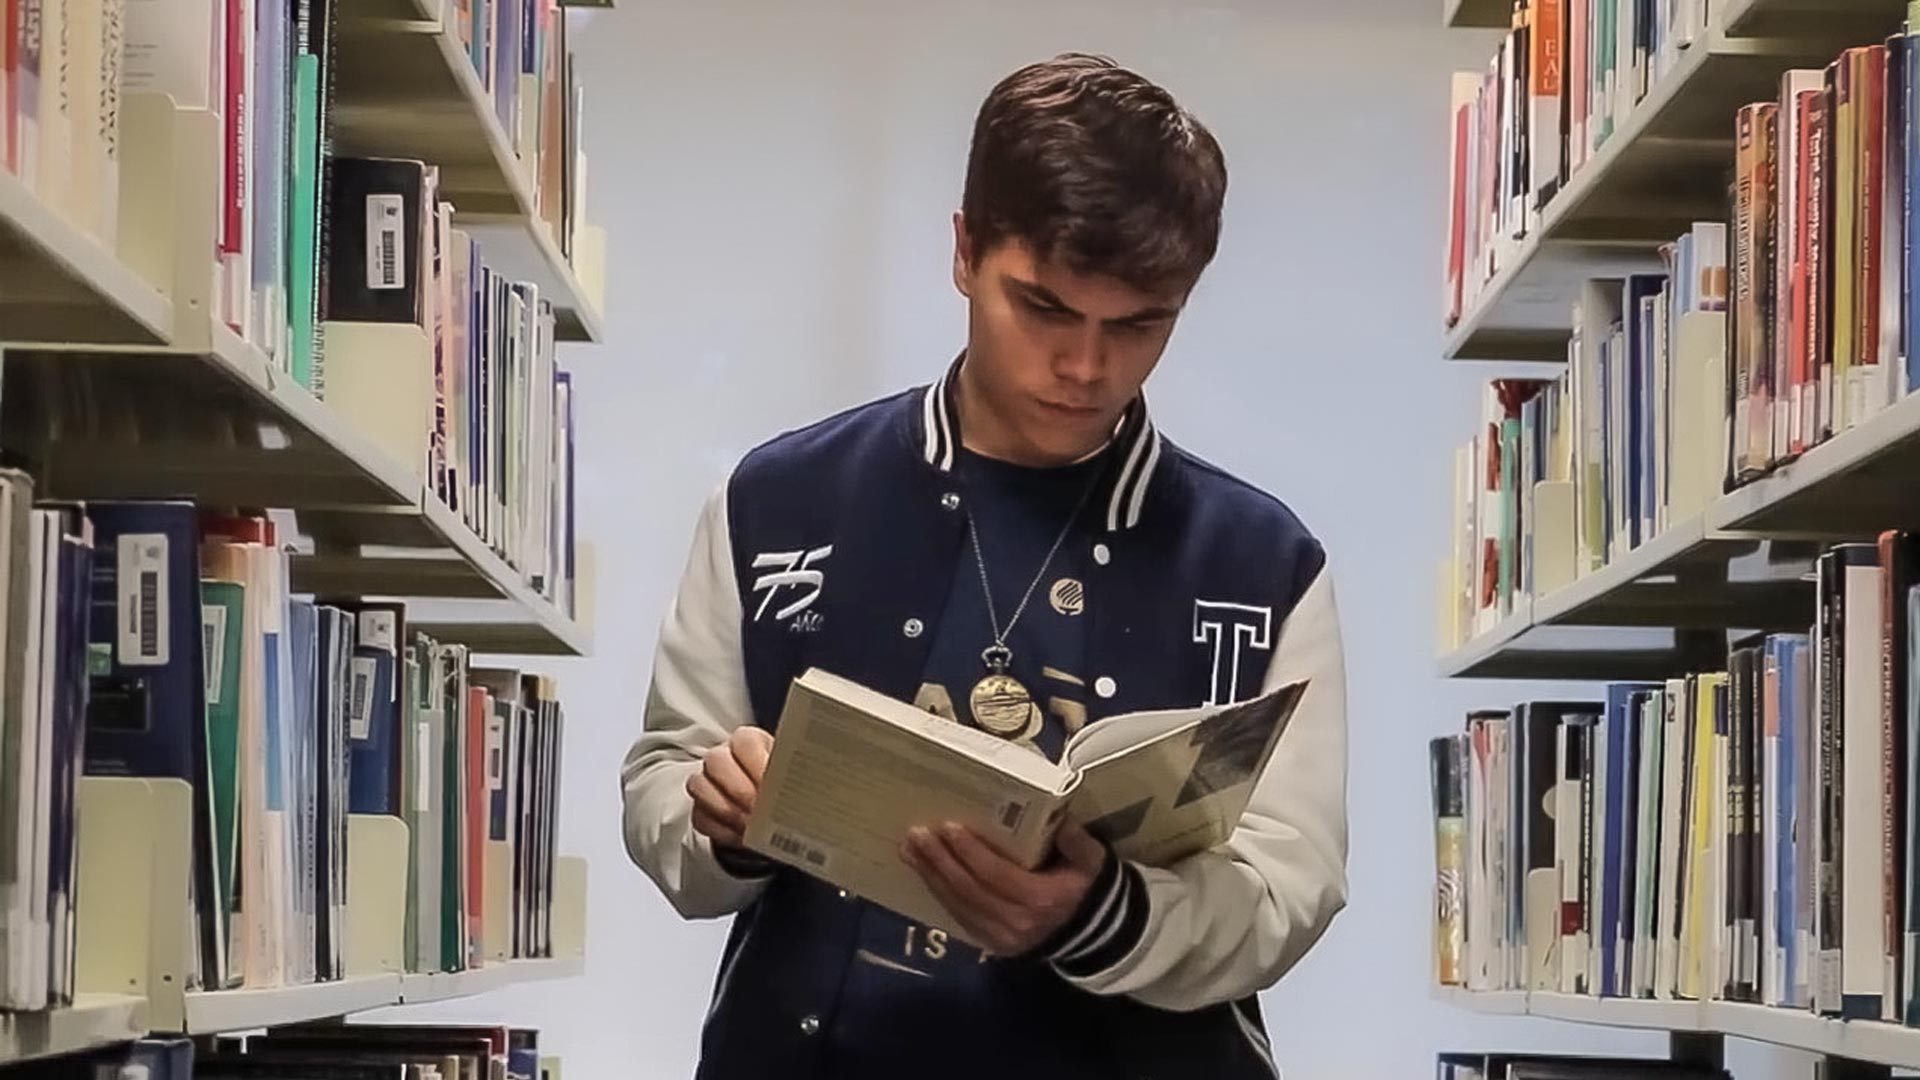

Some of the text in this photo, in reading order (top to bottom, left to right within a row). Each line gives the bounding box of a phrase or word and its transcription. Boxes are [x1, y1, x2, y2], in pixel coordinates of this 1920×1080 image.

[751, 544, 833, 622] 75
[1193, 599, 1271, 707] T
[904, 925, 948, 960] IS
